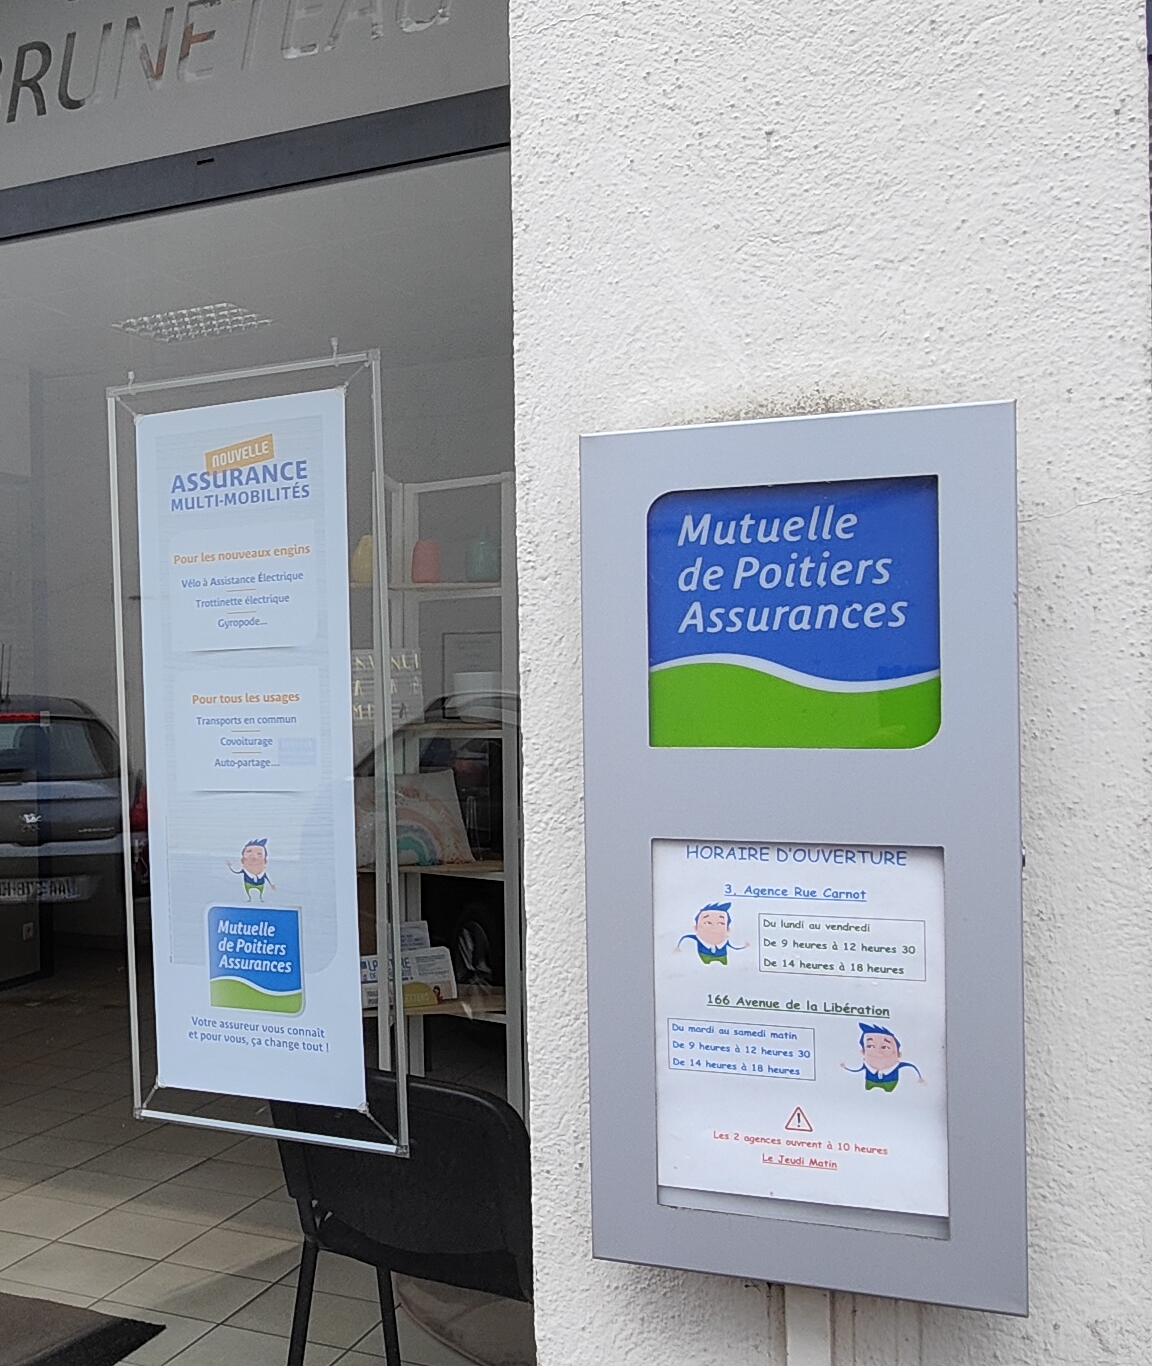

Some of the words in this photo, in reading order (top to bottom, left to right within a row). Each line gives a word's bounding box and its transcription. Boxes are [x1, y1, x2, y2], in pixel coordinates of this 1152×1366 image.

[211, 440, 270, 468] NOUVELLE
[171, 459, 309, 494] ASSURANCE
[171, 483, 311, 512] MULTI-MOBILITÉS
[677, 505, 858, 547] Mutuelle
[173, 555, 199, 565] Pour
[201, 552, 216, 563] les
[218, 549, 271, 561] nouveaux
[273, 544, 310, 558] engins
[181, 579, 201, 588] Vélo
[203, 578, 208, 587] à
[210, 576, 256, 586] Assistance
[258, 571, 304, 584] Électrique
[678, 556, 723, 593] de
[733, 551, 893, 591] Poitiers
[195, 598, 243, 608] Trottinette
[245, 594, 290, 606] électrique
[678, 599, 908, 634] Assurances
[192, 694, 218, 704] Pour
[219, 695, 243, 704] tous
[245, 692, 260, 703] les
[263, 693, 300, 705] usages
[196, 715, 242, 727] Transports
[244, 717, 255, 725] en
[257, 715, 297, 725] commun
[220, 736, 273, 748] Covoiturage
[686, 845, 770, 862] HORAIRE
[776, 847, 908, 867] D'OUVERTURE
[744, 885, 789, 899] Agence
[794, 886, 818, 898] Rue
[822, 887, 867, 901] Carnot
[217, 920, 276, 937] Mutuelle
[763, 919, 776, 928] Du
[781, 919, 804, 929] lundi
[825, 923, 870, 932] vendredi
[217, 937, 234, 953] de
[235, 938, 287, 956] Poitiers
[763, 938, 777, 947] De
[781, 939, 788, 948] 9
[793, 940, 827, 950] heures
[832, 941, 838, 950] à
[844, 942, 856, 951] 12
[861, 943, 897, 953] heures
[902, 945, 916, 954] 30
[218, 954, 292, 974] Assurances
[764, 958, 777, 967] De
[783, 959, 795, 967] 14
[800, 960, 834, 970] heures
[839, 962, 845, 971] à
[851, 963, 863, 972] 18
[867, 963, 904, 974] heures
[707, 993, 731, 1006] 166
[735, 996, 781, 1010] Avenue
[785, 999, 802, 1011] de
[806, 1000, 819, 1012] la
[823, 1001, 891, 1017] Libération
[191, 1016, 217, 1028] Votre
[219, 1021, 259, 1031] assureur
[262, 1025, 285, 1034] vous
[287, 1027, 325, 1038] connaît
[672, 1023, 684, 1032] Du
[688, 1026, 714, 1034] mardi
[734, 1029, 766, 1037] samedi
[770, 1032, 797, 1040] matin
[188, 1031, 198, 1039] et
[200, 1032, 222, 1042] pour
[224, 1035, 249, 1046] vous,
[251, 1037, 262, 1047] ça
[264, 1037, 299, 1051] change
[301, 1042, 323, 1052] tout
[672, 1040, 685, 1049] De
[688, 1041, 695, 1049] 9
[699, 1042, 730, 1052] heures
[734, 1044, 741, 1053] à
[745, 1046, 757, 1054] 12
[761, 1047, 793, 1057] heures
[798, 1050, 811, 1058] 30
[672, 1057, 687, 1067] De
[690, 1059, 701, 1067] 14
[706, 1060, 737, 1070] heures
[741, 1062, 747, 1071] à
[752, 1064, 763, 1072] 18
[768, 1065, 800, 1075] heures
[713, 1131, 729, 1140] Les
[734, 1132, 740, 1141] 2
[744, 1136, 781, 1145] agences
[785, 1140, 822, 1149] ouvrent
[826, 1141, 833, 1150] à
[838, 1142, 850, 1151] 10
[854, 1144, 888, 1155] heures
[762, 1153, 775, 1164] Le
[778, 1154, 806, 1167] Jeudi
[808, 1156, 838, 1169] Matin
